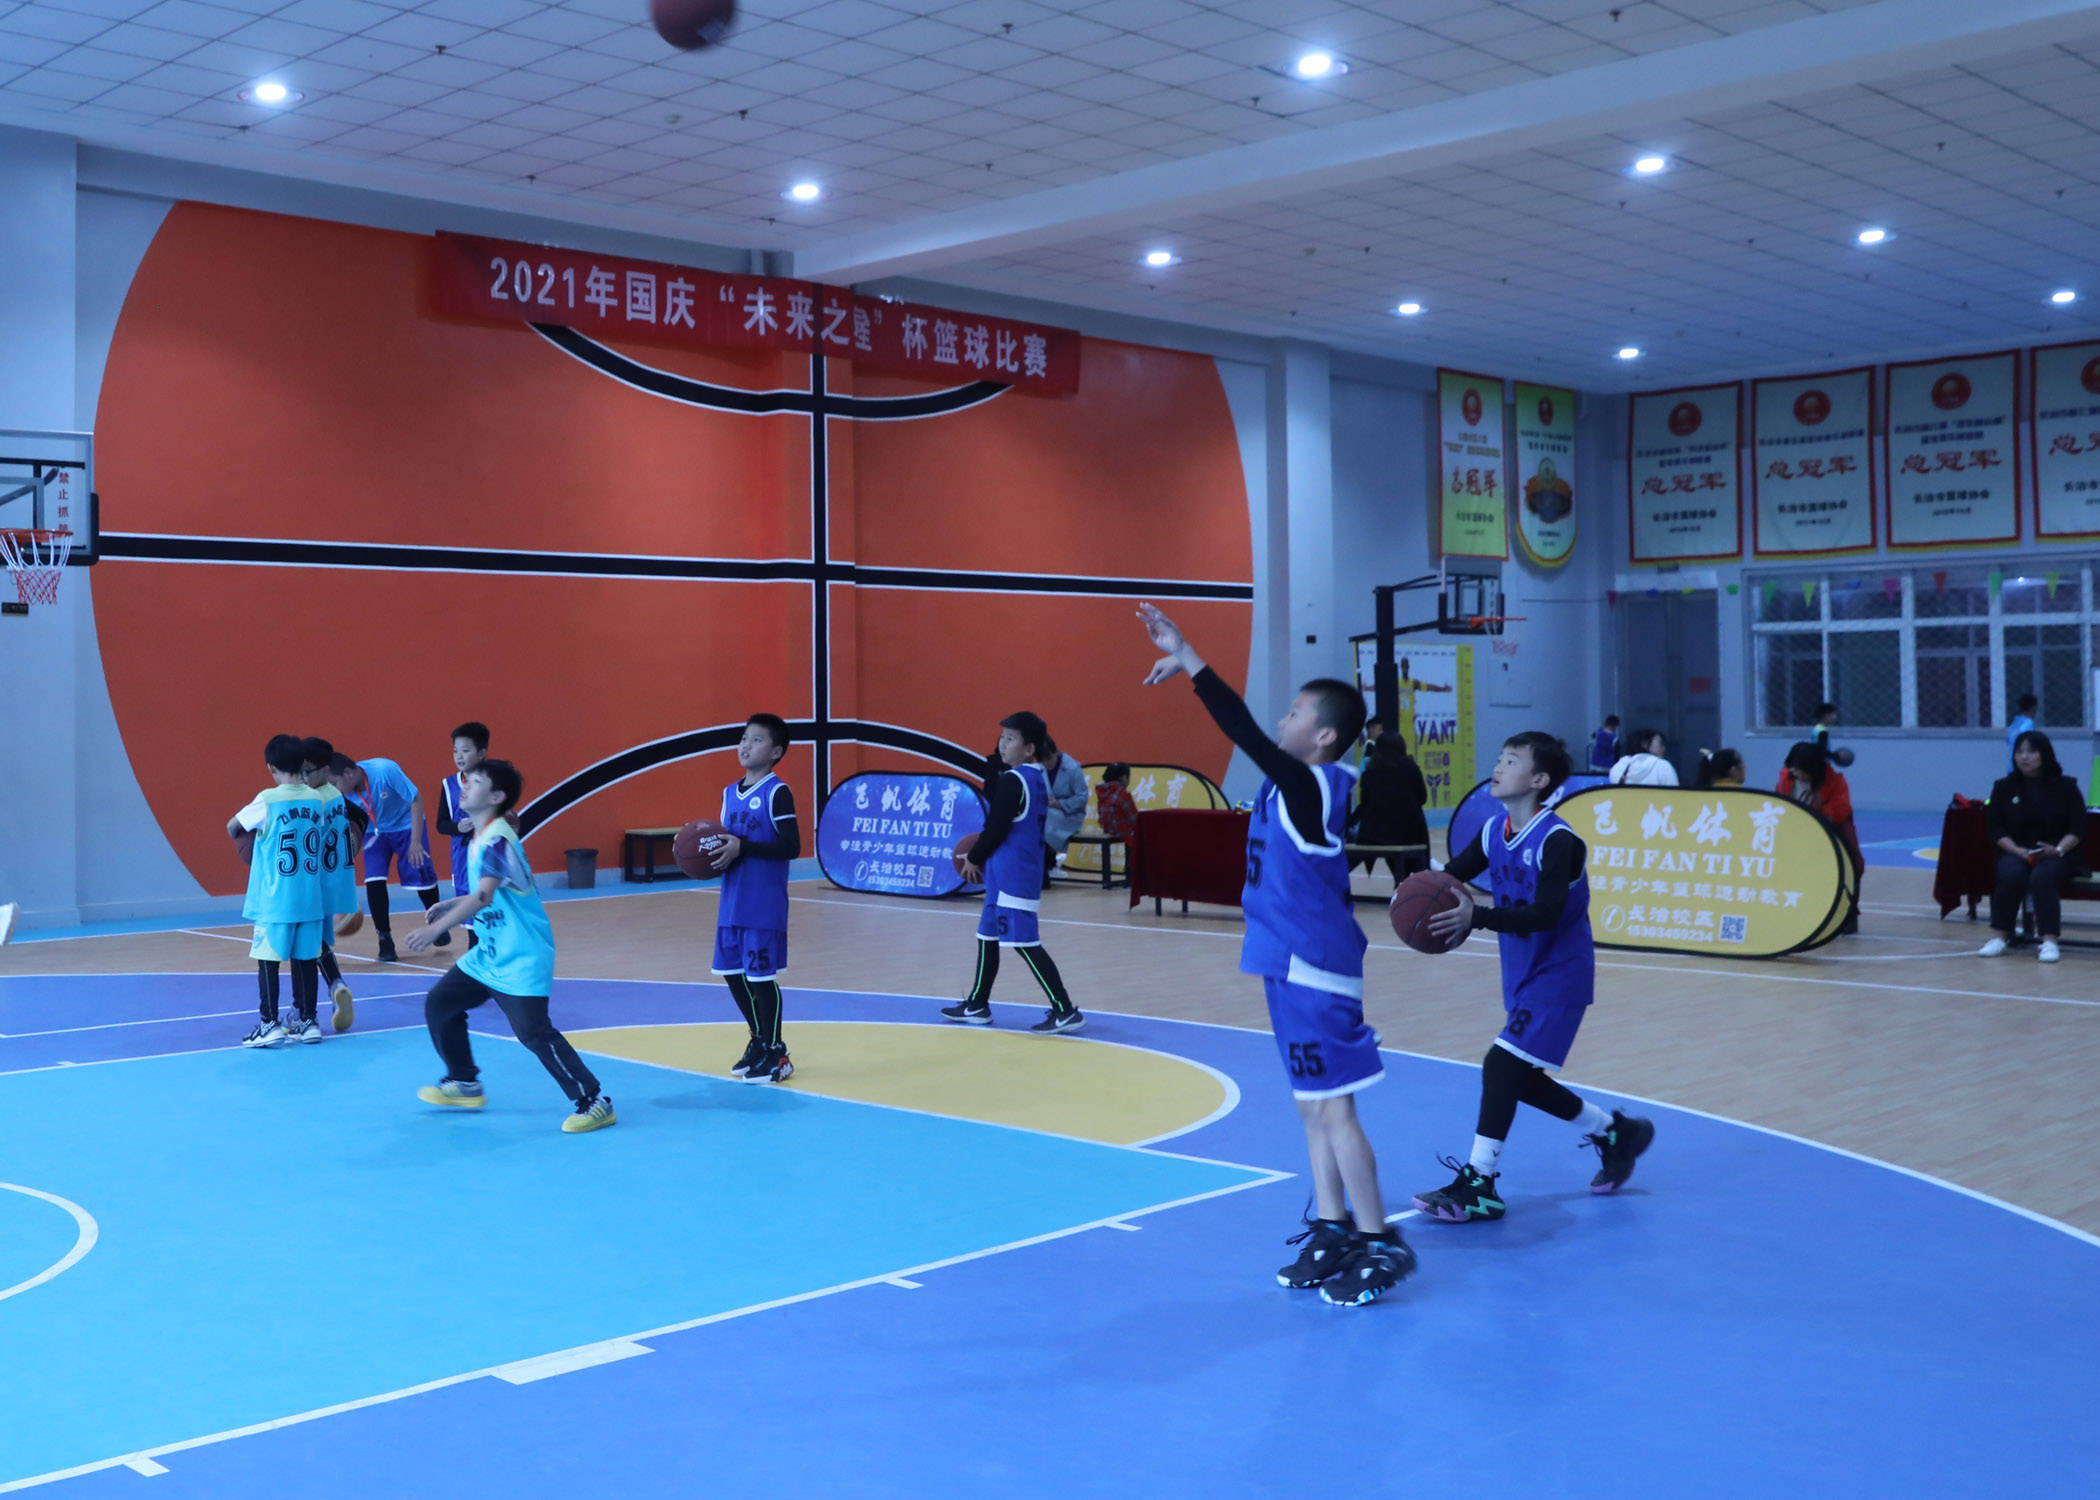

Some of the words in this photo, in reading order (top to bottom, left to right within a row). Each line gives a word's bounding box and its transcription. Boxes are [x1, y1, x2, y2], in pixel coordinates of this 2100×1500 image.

[1765, 456, 1858, 480] 总冠军
[1899, 449, 2002, 475] 总冠军
[1641, 472, 1727, 495] 总冠军
[852, 817, 879, 833] FEI
[880, 819, 911, 836] FAN
[913, 821, 931, 837] TI
[932, 822, 953, 838] YU
[277, 827, 320, 877] 59
[1591, 845, 1637, 869] FEI
[1641, 849, 1698, 873] FAN
[1703, 853, 1732, 876] TI
[1739, 855, 1776, 878] YU
[747, 948, 770, 971] 25
[1288, 1040, 1326, 1079] 55
